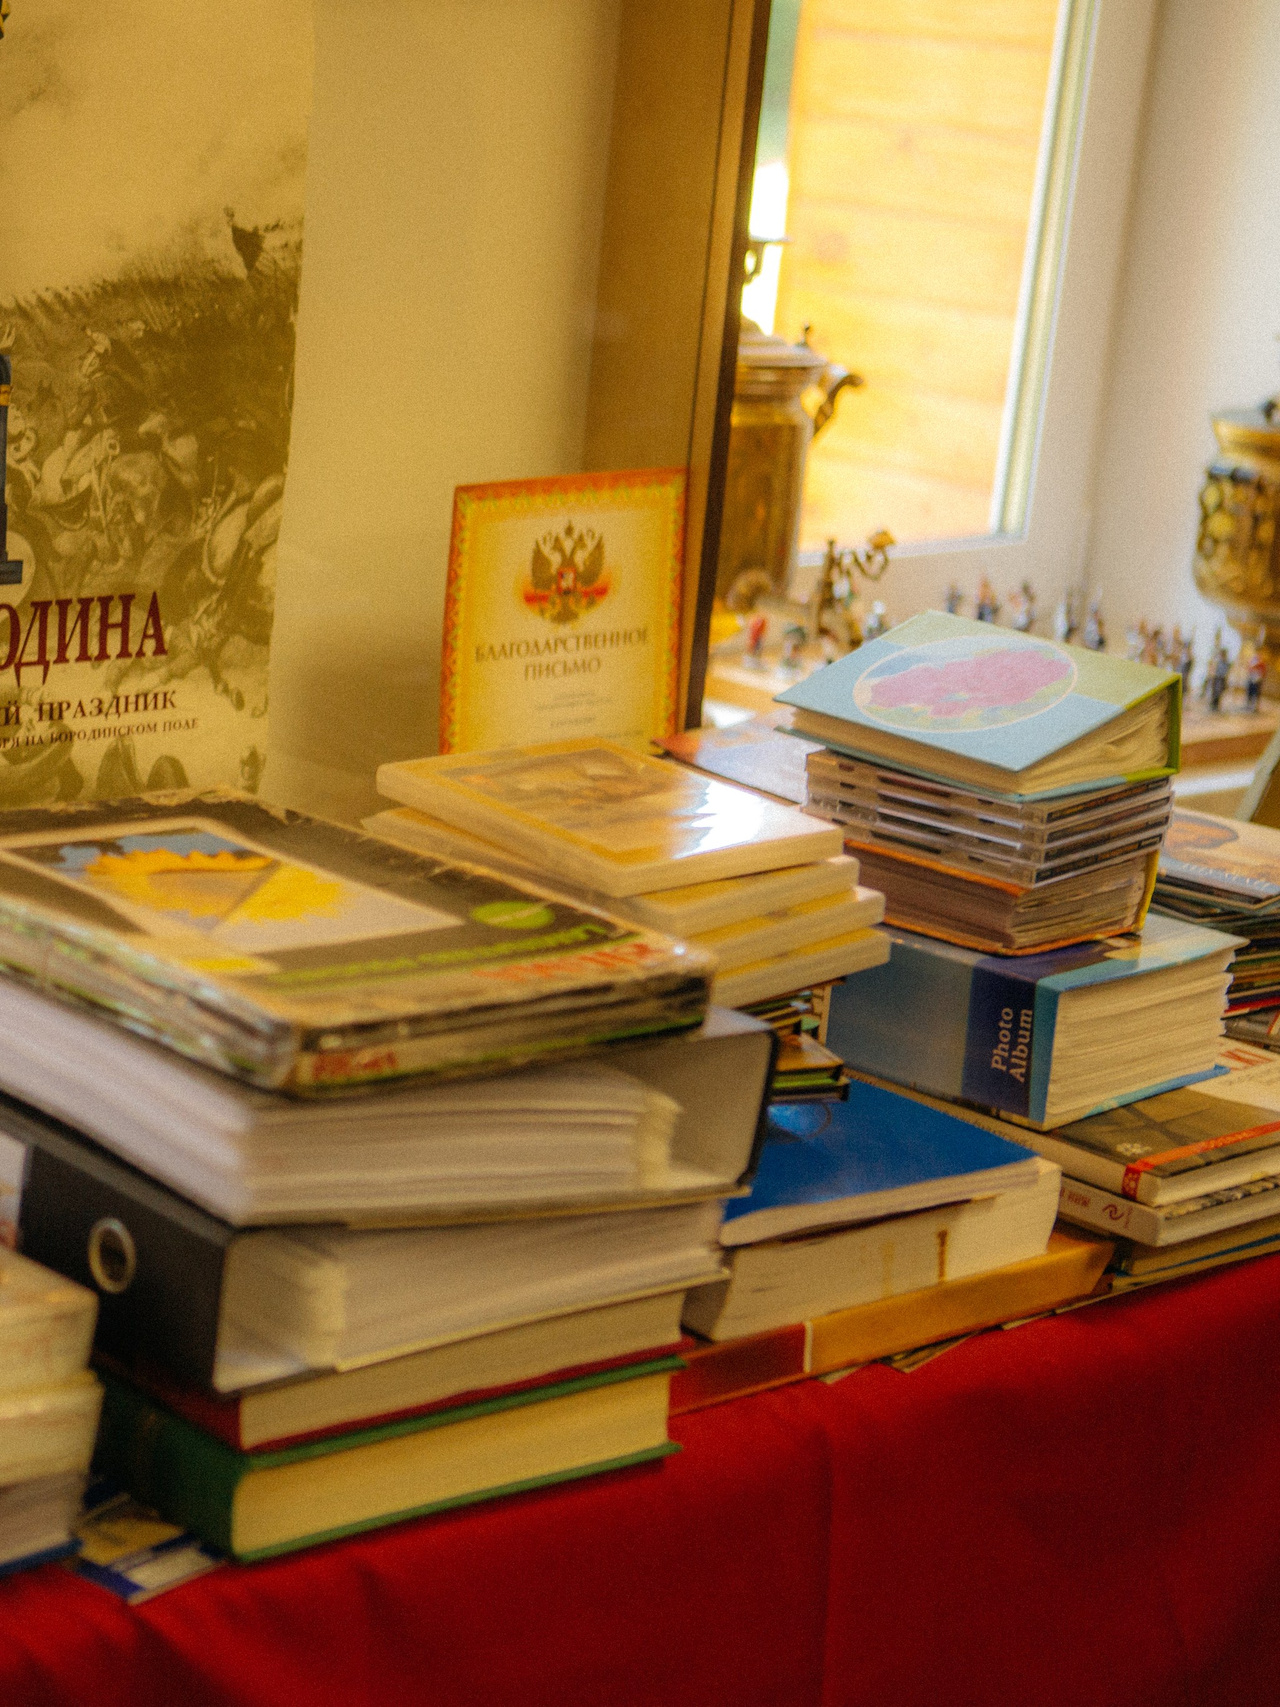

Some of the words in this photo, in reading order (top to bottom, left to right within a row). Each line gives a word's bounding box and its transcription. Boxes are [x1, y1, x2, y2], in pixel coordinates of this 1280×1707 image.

[475, 628, 648, 663] БЛАГОДАРСТВЕННОЕ
[524, 657, 602, 681] ПИСЬМО
[37, 690, 177, 722] ПРАЗДНИК
[25, 735, 45, 747] НА
[50, 722, 157, 744] БОРОДИНСКОМ
[162, 718, 199, 733] ПОЛЕ
[991, 1007, 1014, 1072] Photo
[1009, 1009, 1033, 1084] Album
